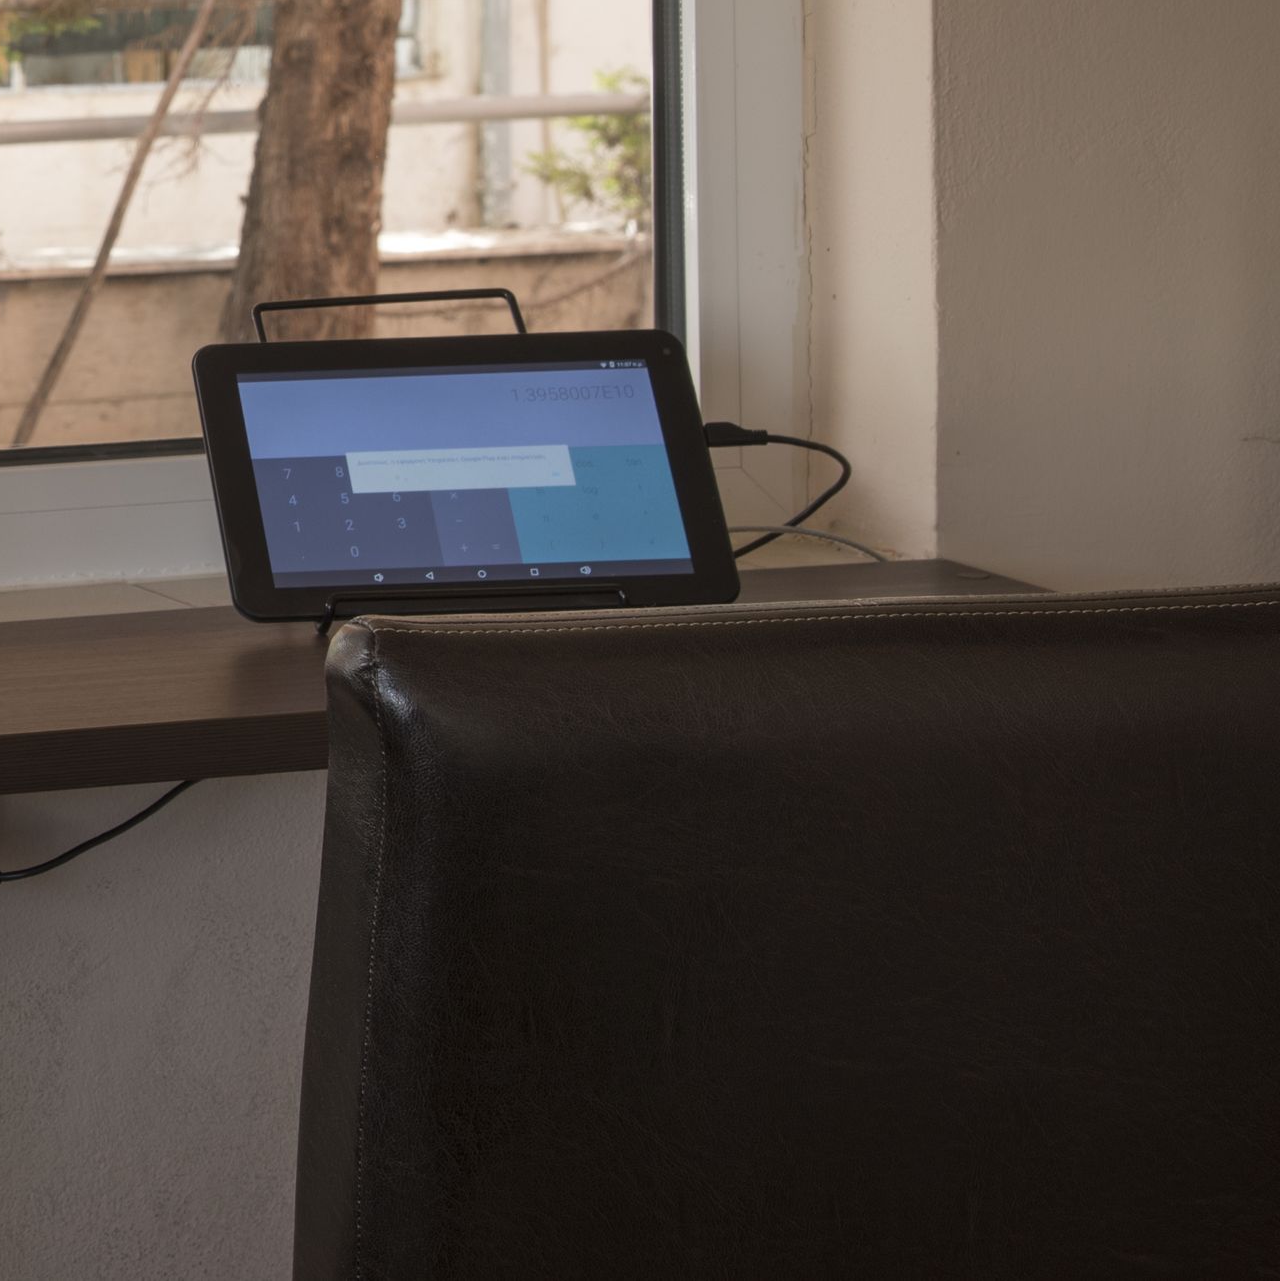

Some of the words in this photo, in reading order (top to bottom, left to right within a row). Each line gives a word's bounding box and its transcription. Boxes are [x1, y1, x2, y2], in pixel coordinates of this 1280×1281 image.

[283, 468, 291, 479] 7
[335, 466, 344, 478] 8
[289, 494, 297, 505] 4
[341, 492, 349, 504] 5
[392, 491, 401, 502] 6
[293, 521, 301, 532] 1
[346, 519, 355, 531] 2
[397, 517, 406, 529] 3
[350, 545, 359, 558] 0
